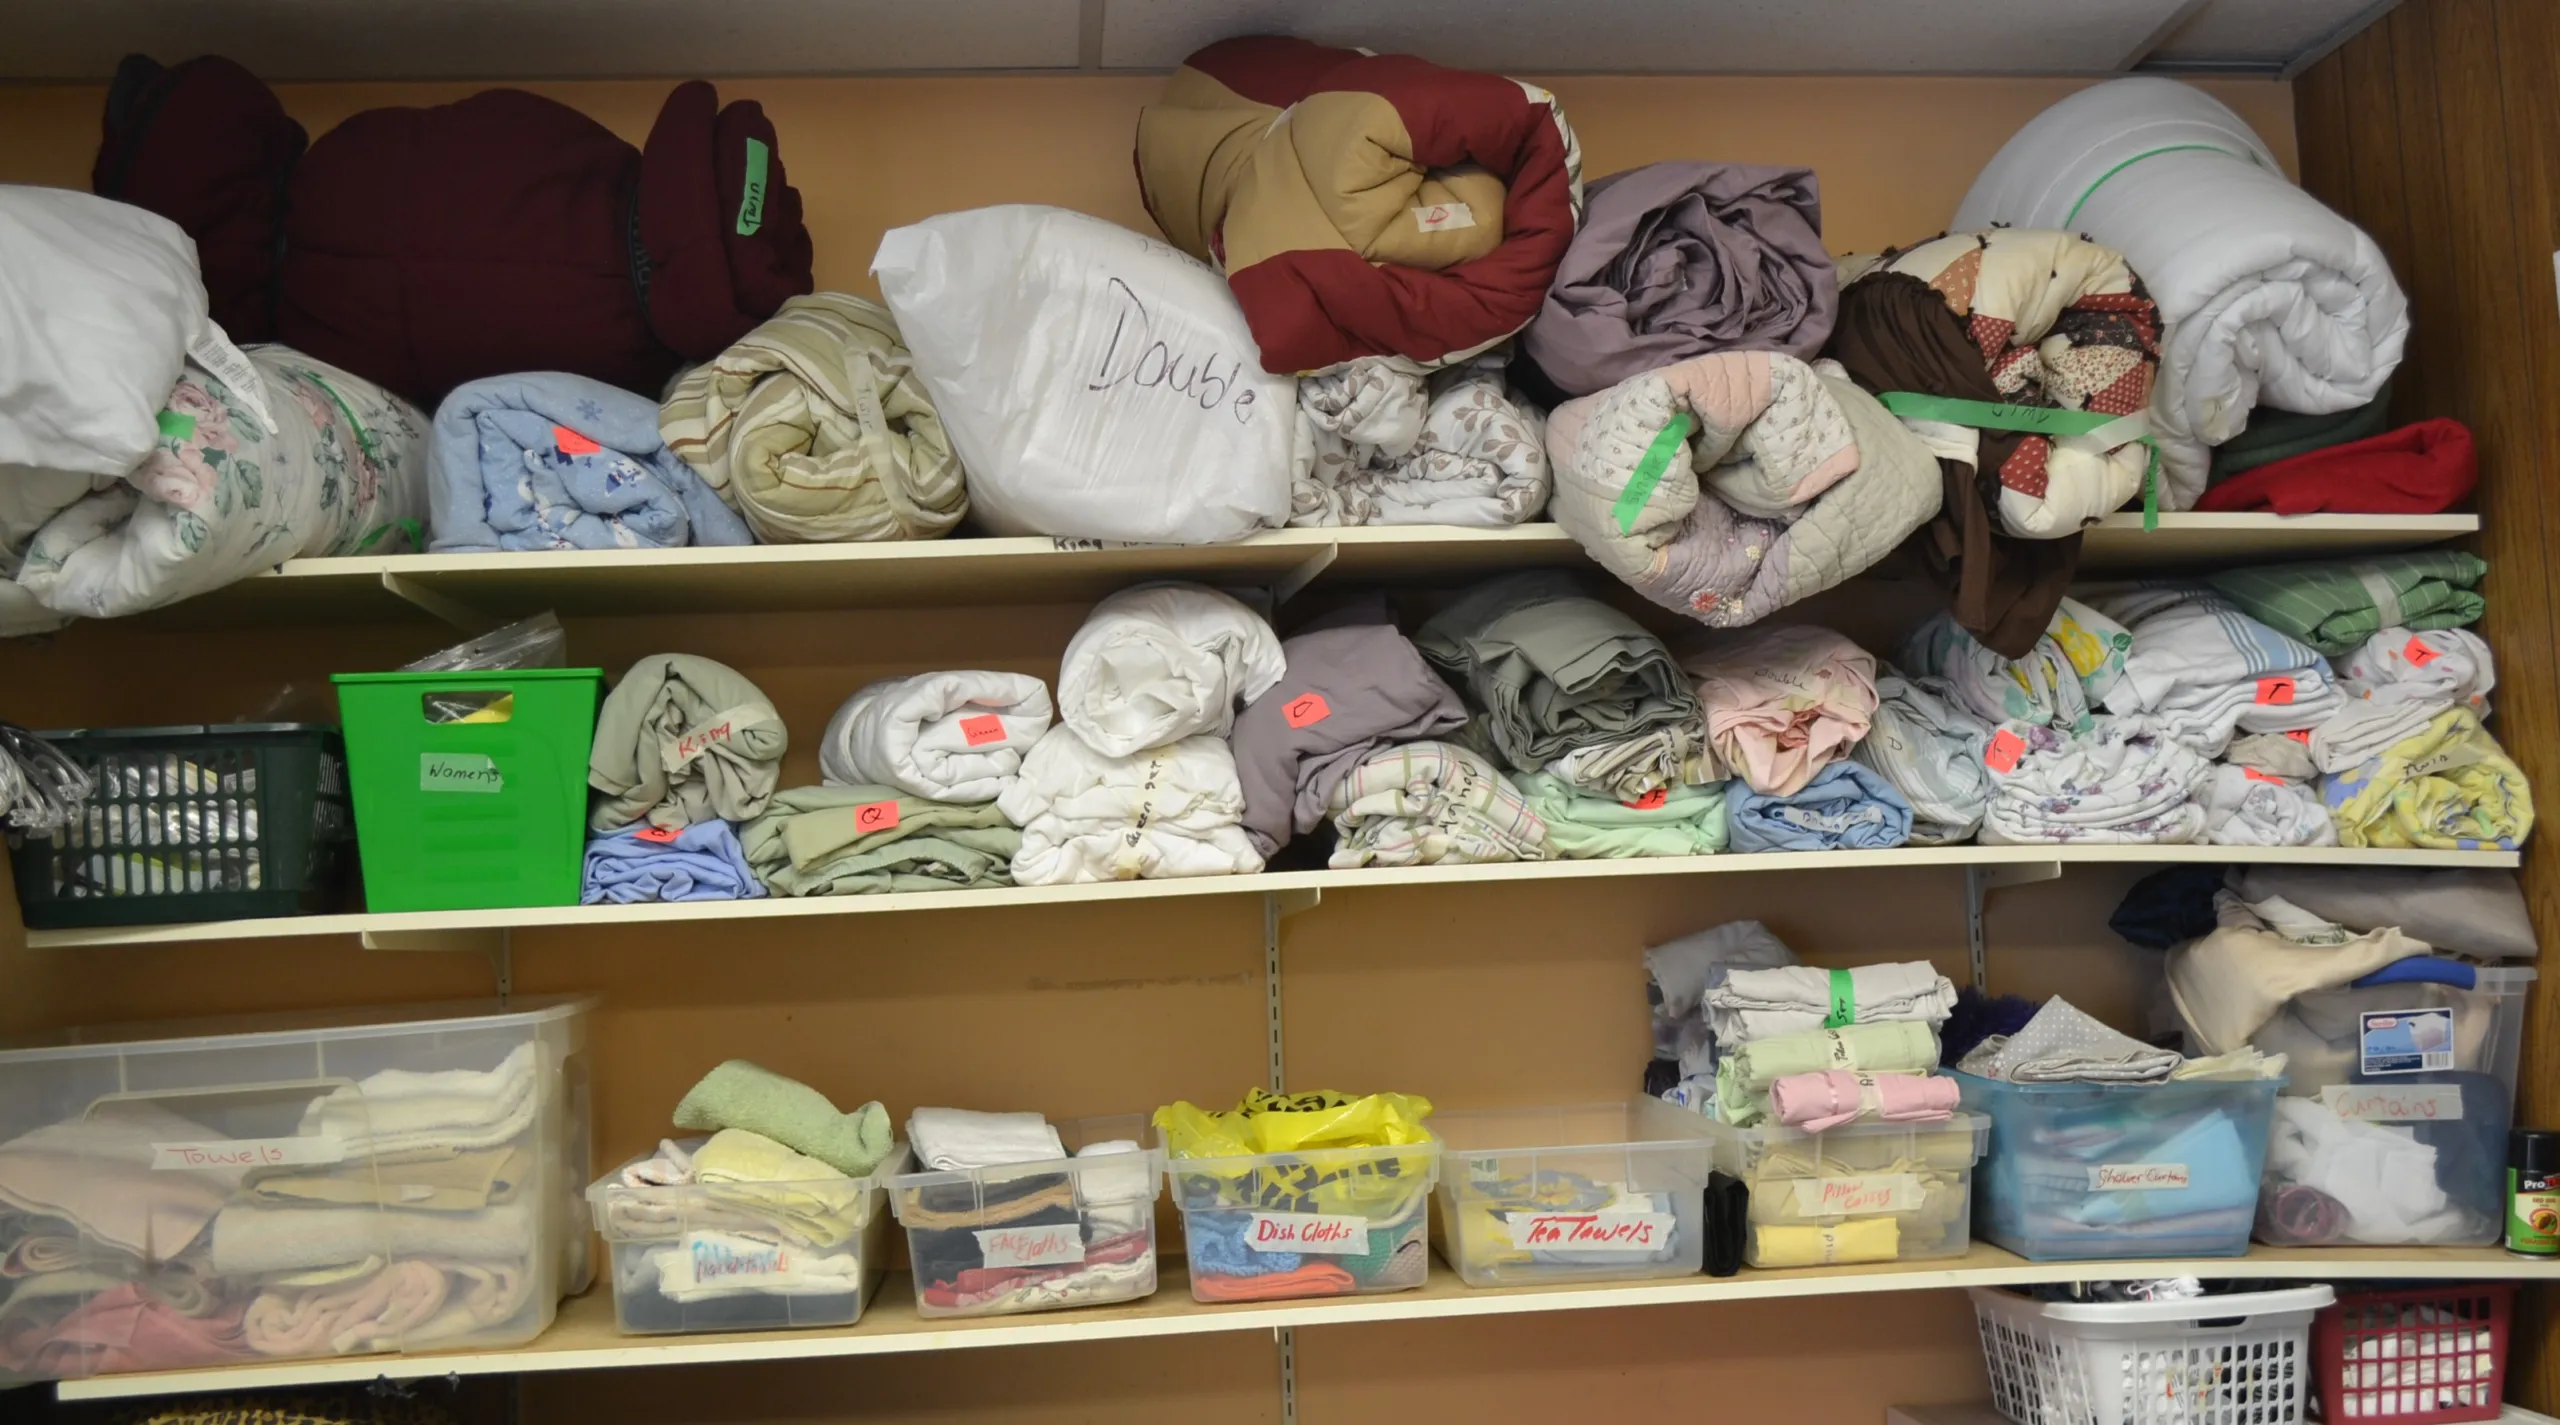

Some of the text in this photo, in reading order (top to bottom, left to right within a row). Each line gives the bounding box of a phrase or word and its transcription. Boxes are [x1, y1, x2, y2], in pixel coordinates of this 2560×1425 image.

[742, 182, 761, 228] Twin
[1425, 206, 1450, 224] D
[1089, 276, 1256, 424] Double
[2268, 682, 2291, 700] T
[678, 720, 733, 760] King
[862, 807, 884, 824] Q
[2335, 1093, 2437, 1118] Curtains
[166, 1146, 284, 1166] Towels
[2096, 1168, 2143, 1188] Shower
[1256, 1219, 1353, 1243] Dish Cloths
[1526, 1215, 1654, 1245] Tea Towels
